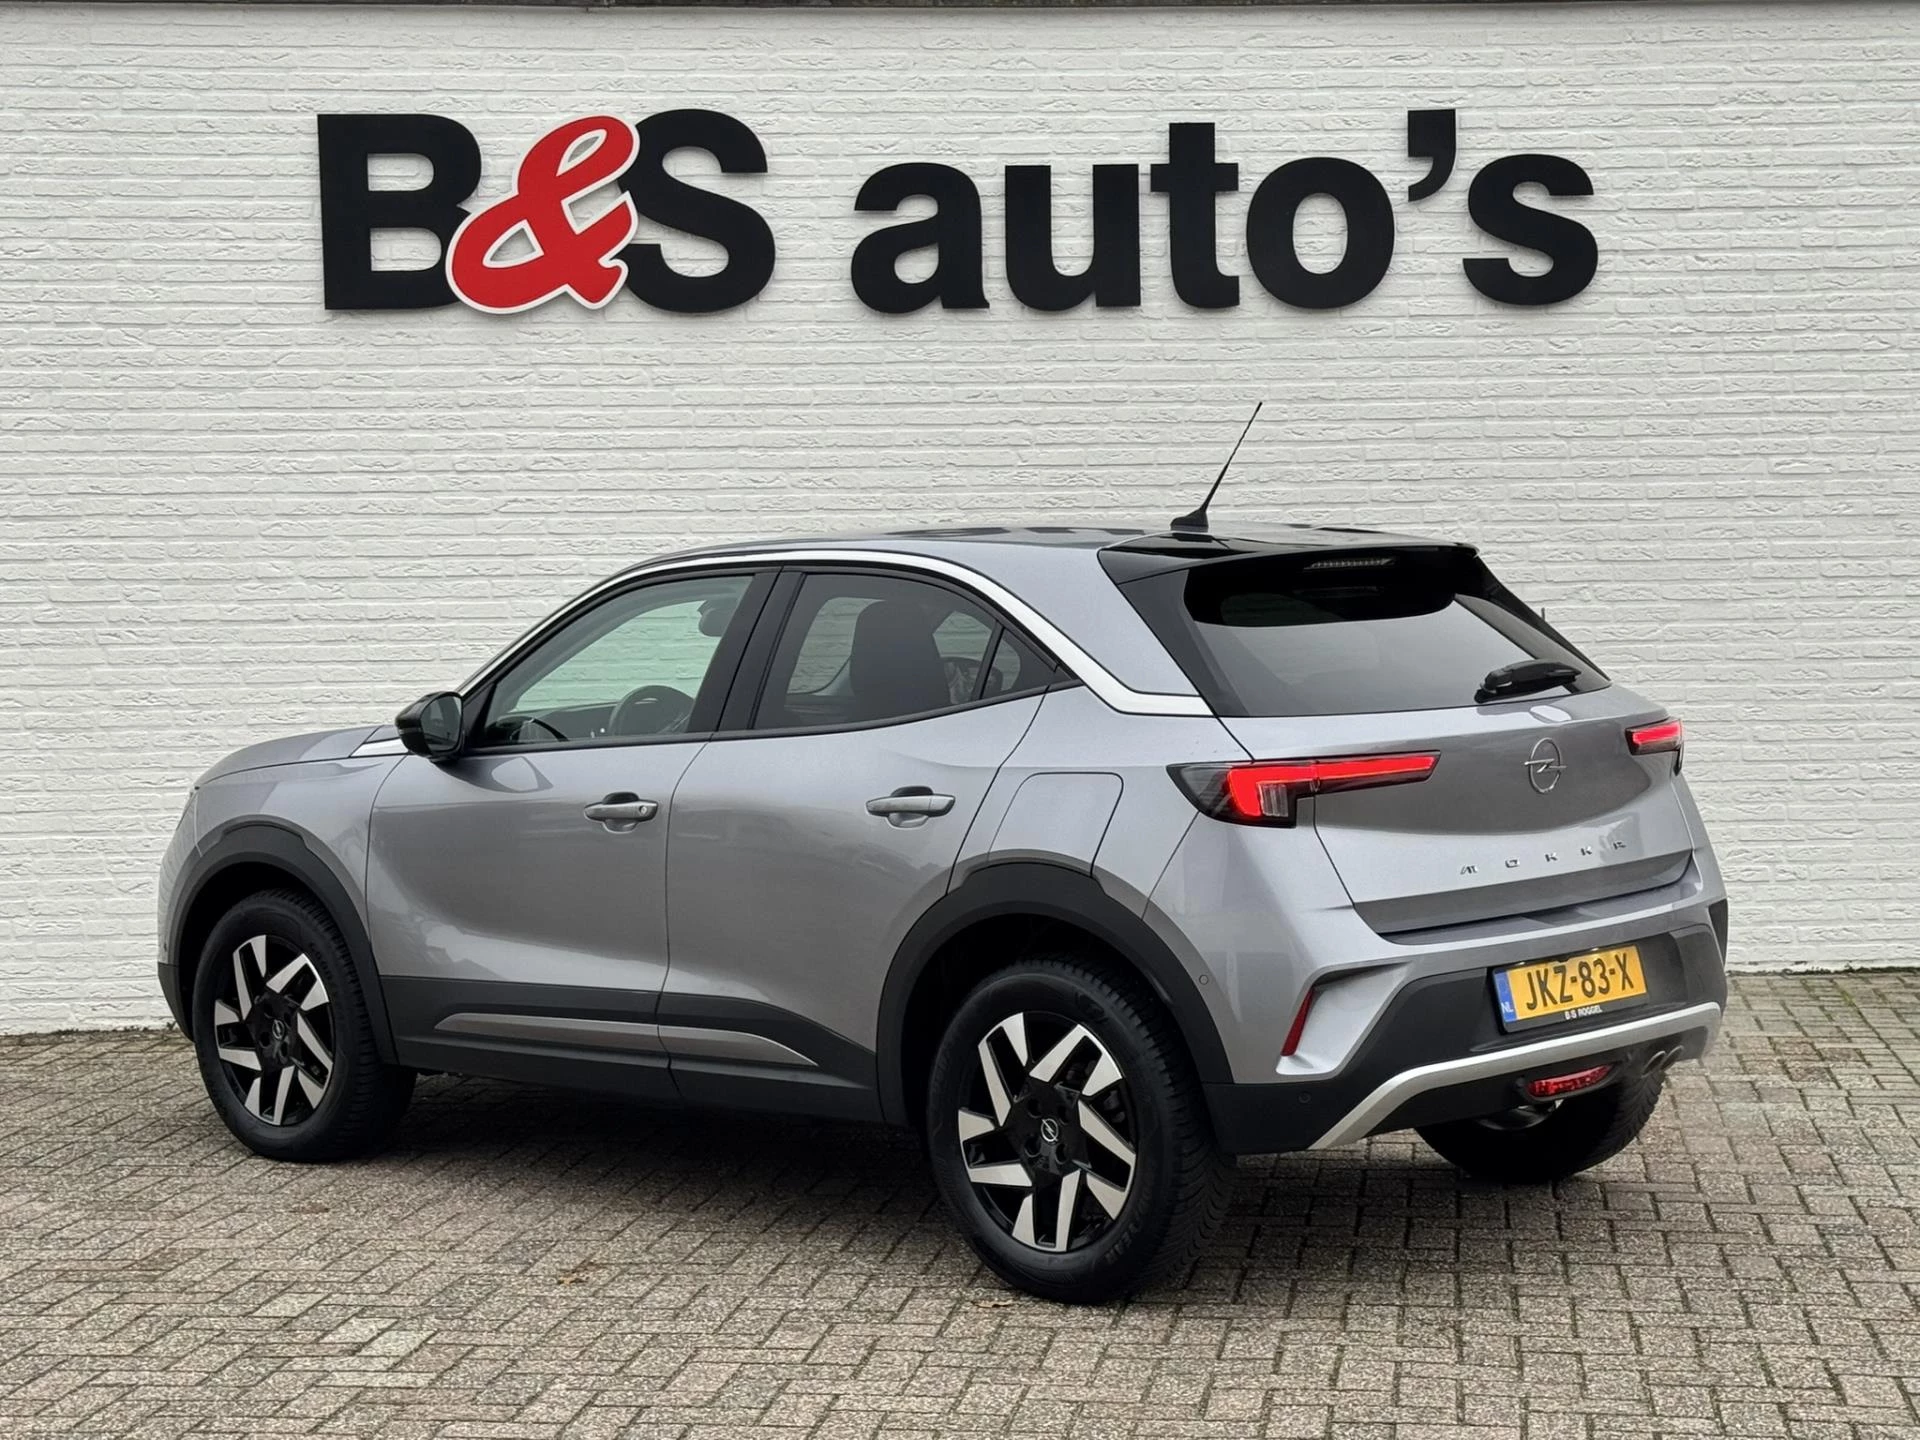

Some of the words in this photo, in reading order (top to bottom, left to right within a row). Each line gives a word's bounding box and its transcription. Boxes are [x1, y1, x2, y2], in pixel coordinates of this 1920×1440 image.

[317, 109, 776, 314] B&S
[850, 109, 1599, 314] auto's
[1500, 1001, 1514, 1014] NL
[1526, 952, 1635, 1011] JKZ-83-X
